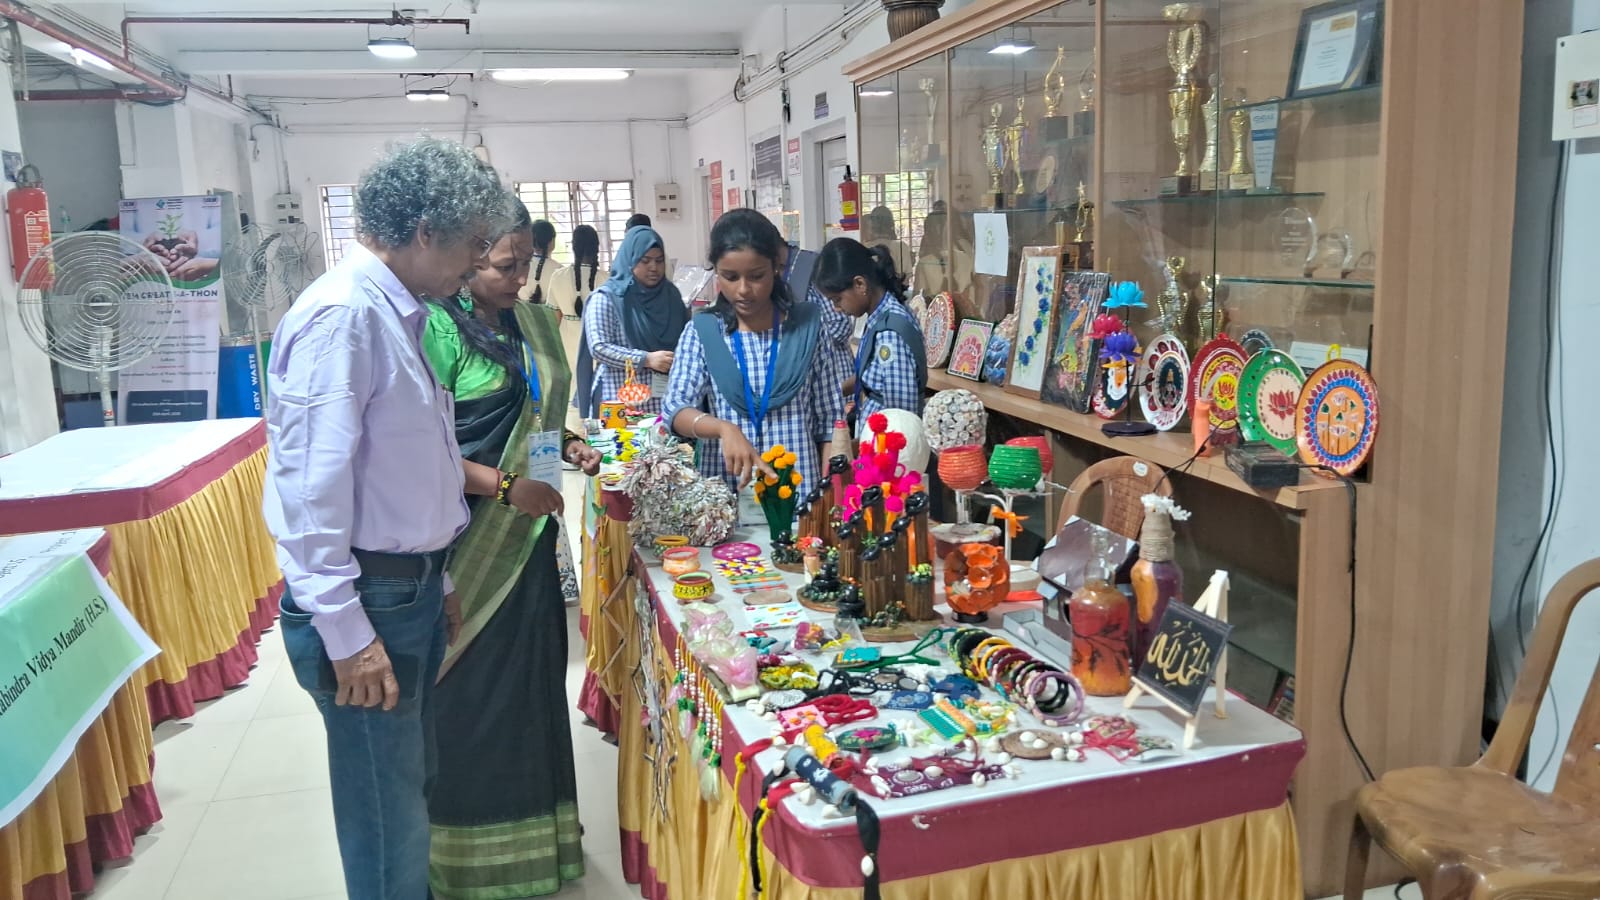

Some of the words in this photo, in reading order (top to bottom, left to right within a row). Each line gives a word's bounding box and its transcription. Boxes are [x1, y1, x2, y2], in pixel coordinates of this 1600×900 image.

[249, 353, 259, 386] WASTE
[252, 391, 261, 411] DRY
[26, 648, 57, 678] Vidya
[53, 617, 87, 655] Mandir
[84, 595, 109, 629] (H.S.)
